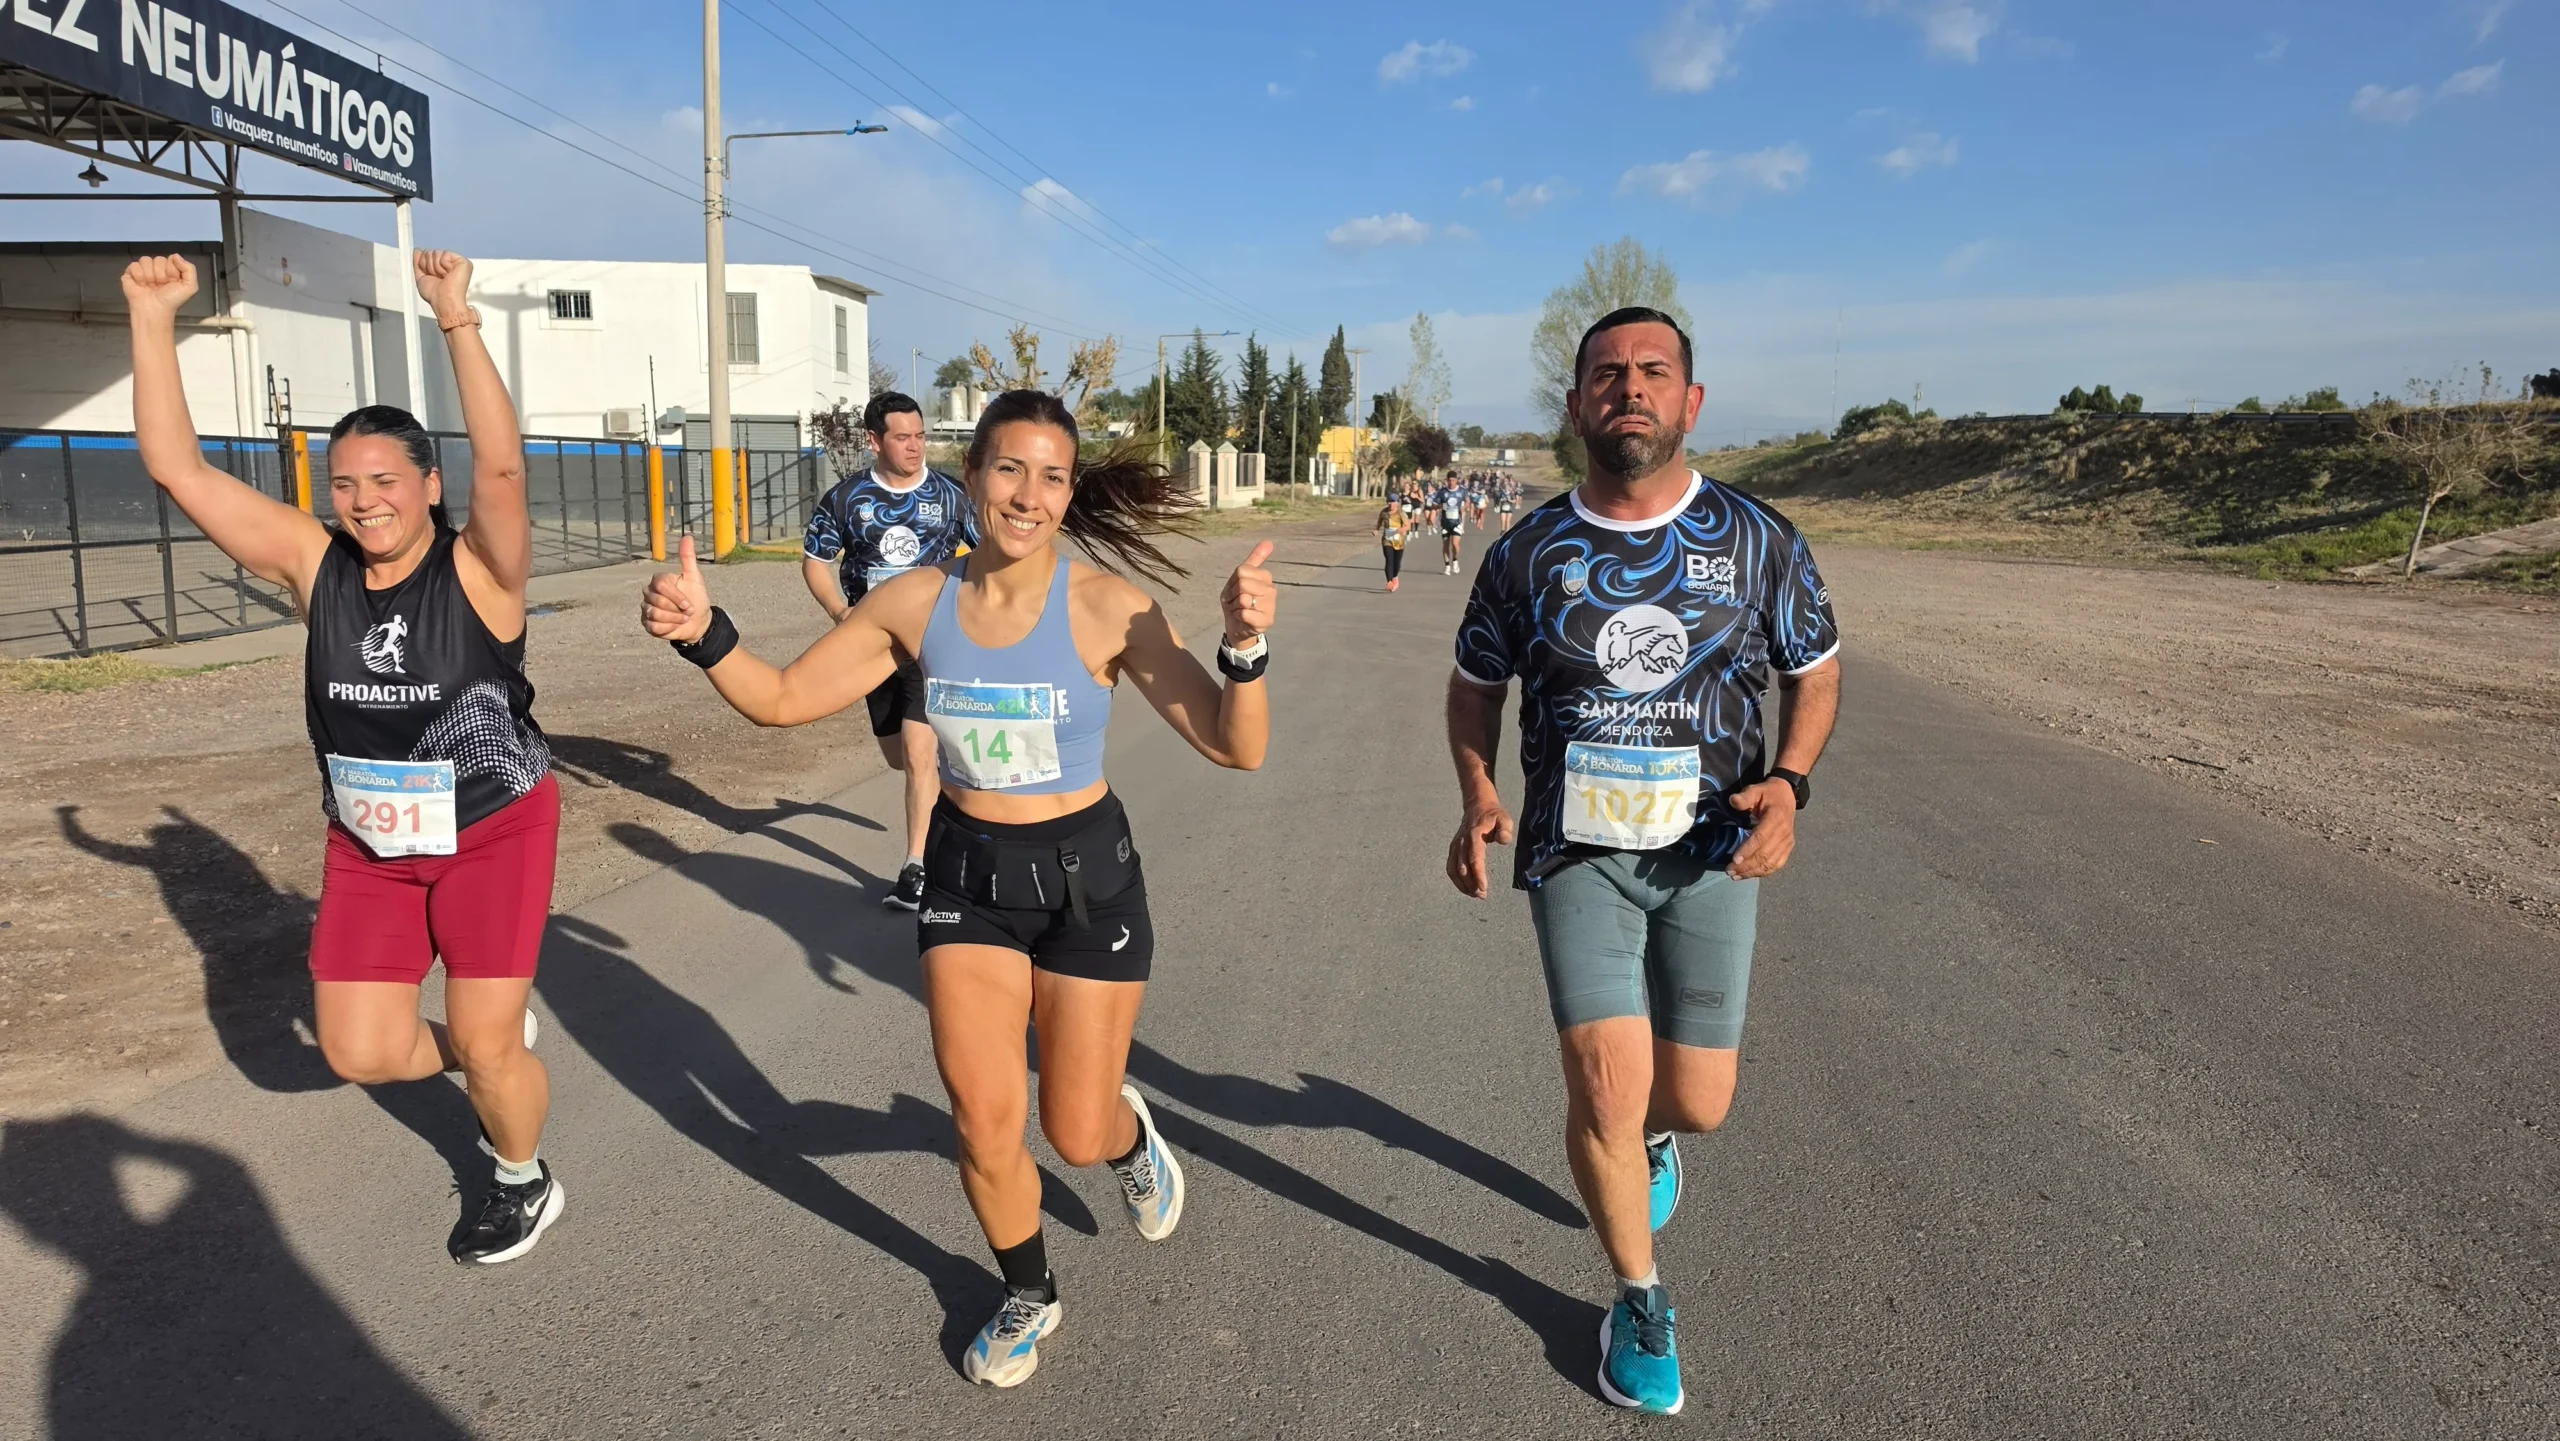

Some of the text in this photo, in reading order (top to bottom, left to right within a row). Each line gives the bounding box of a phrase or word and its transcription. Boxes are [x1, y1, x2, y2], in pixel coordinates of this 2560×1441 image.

[121, 0, 416, 168] NEUMÁTICOS
[224, 113, 339, 167] Vazquez neumaticos
[352, 156, 418, 193] Vazneumaticos
[1687, 580, 1735, 595] BONARDA
[328, 681, 441, 702] PROACTIVE
[945, 699, 996, 712] BONARDA
[1578, 698, 1700, 720] SAN MARTÍN
[1600, 725, 1674, 737] MENDOZA
[963, 728, 1013, 764] 14
[1590, 760, 1645, 774] BONARDA
[347, 774, 398, 787] BONARDA
[352, 798, 421, 834] 291
[1581, 785, 1684, 825] 1027
